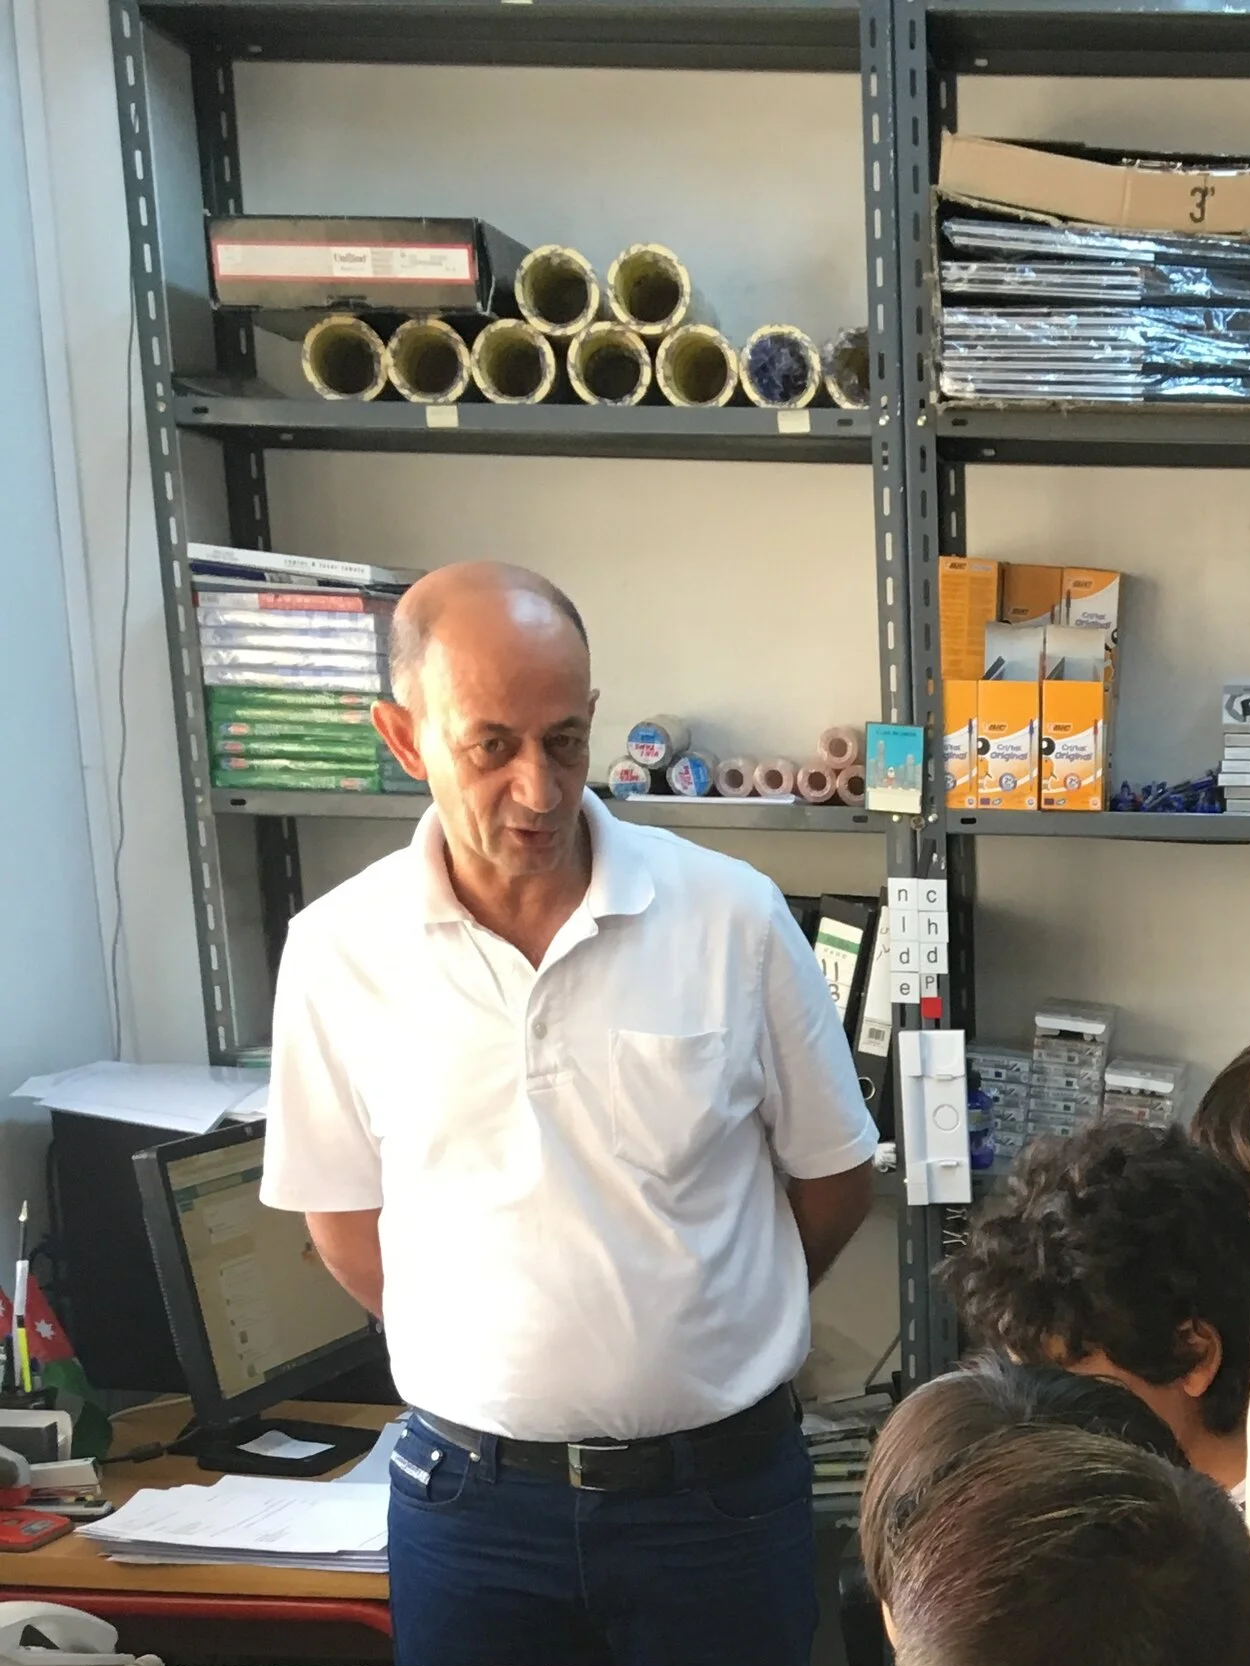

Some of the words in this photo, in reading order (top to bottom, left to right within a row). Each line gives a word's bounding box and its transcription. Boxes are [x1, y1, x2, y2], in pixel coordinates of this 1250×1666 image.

[987, 723, 1007, 732] BIC
[1052, 723, 1072, 732] BIC
[990, 752, 1028, 762] Original
[1054, 752, 1093, 762] Original
[898, 888, 908, 902] n
[927, 918, 938, 935] h
[899, 947, 910, 965] d
[927, 946, 938, 964] d
[899, 982, 911, 996] e
[925, 975, 935, 990] P
